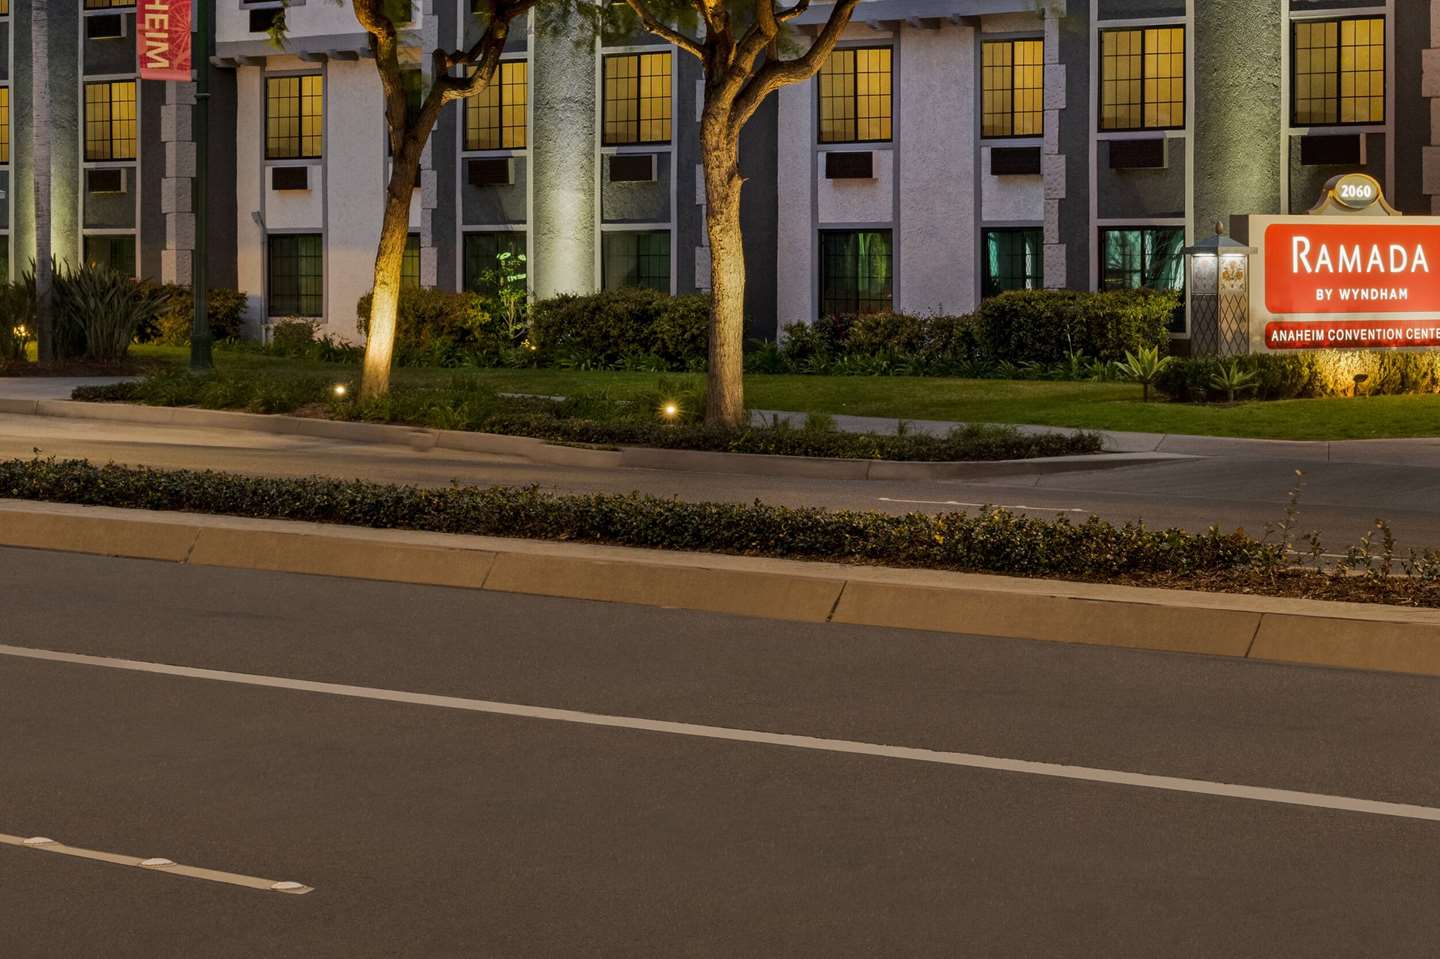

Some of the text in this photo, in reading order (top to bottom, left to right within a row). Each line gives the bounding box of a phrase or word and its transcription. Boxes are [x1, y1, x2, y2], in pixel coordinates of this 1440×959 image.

[1341, 184, 1372, 198] 2060
[1316, 288, 1408, 301] BY WYNDHAM
[1271, 329, 1325, 342] ANAHEIM
[1328, 327, 1402, 341] CONVENTION
